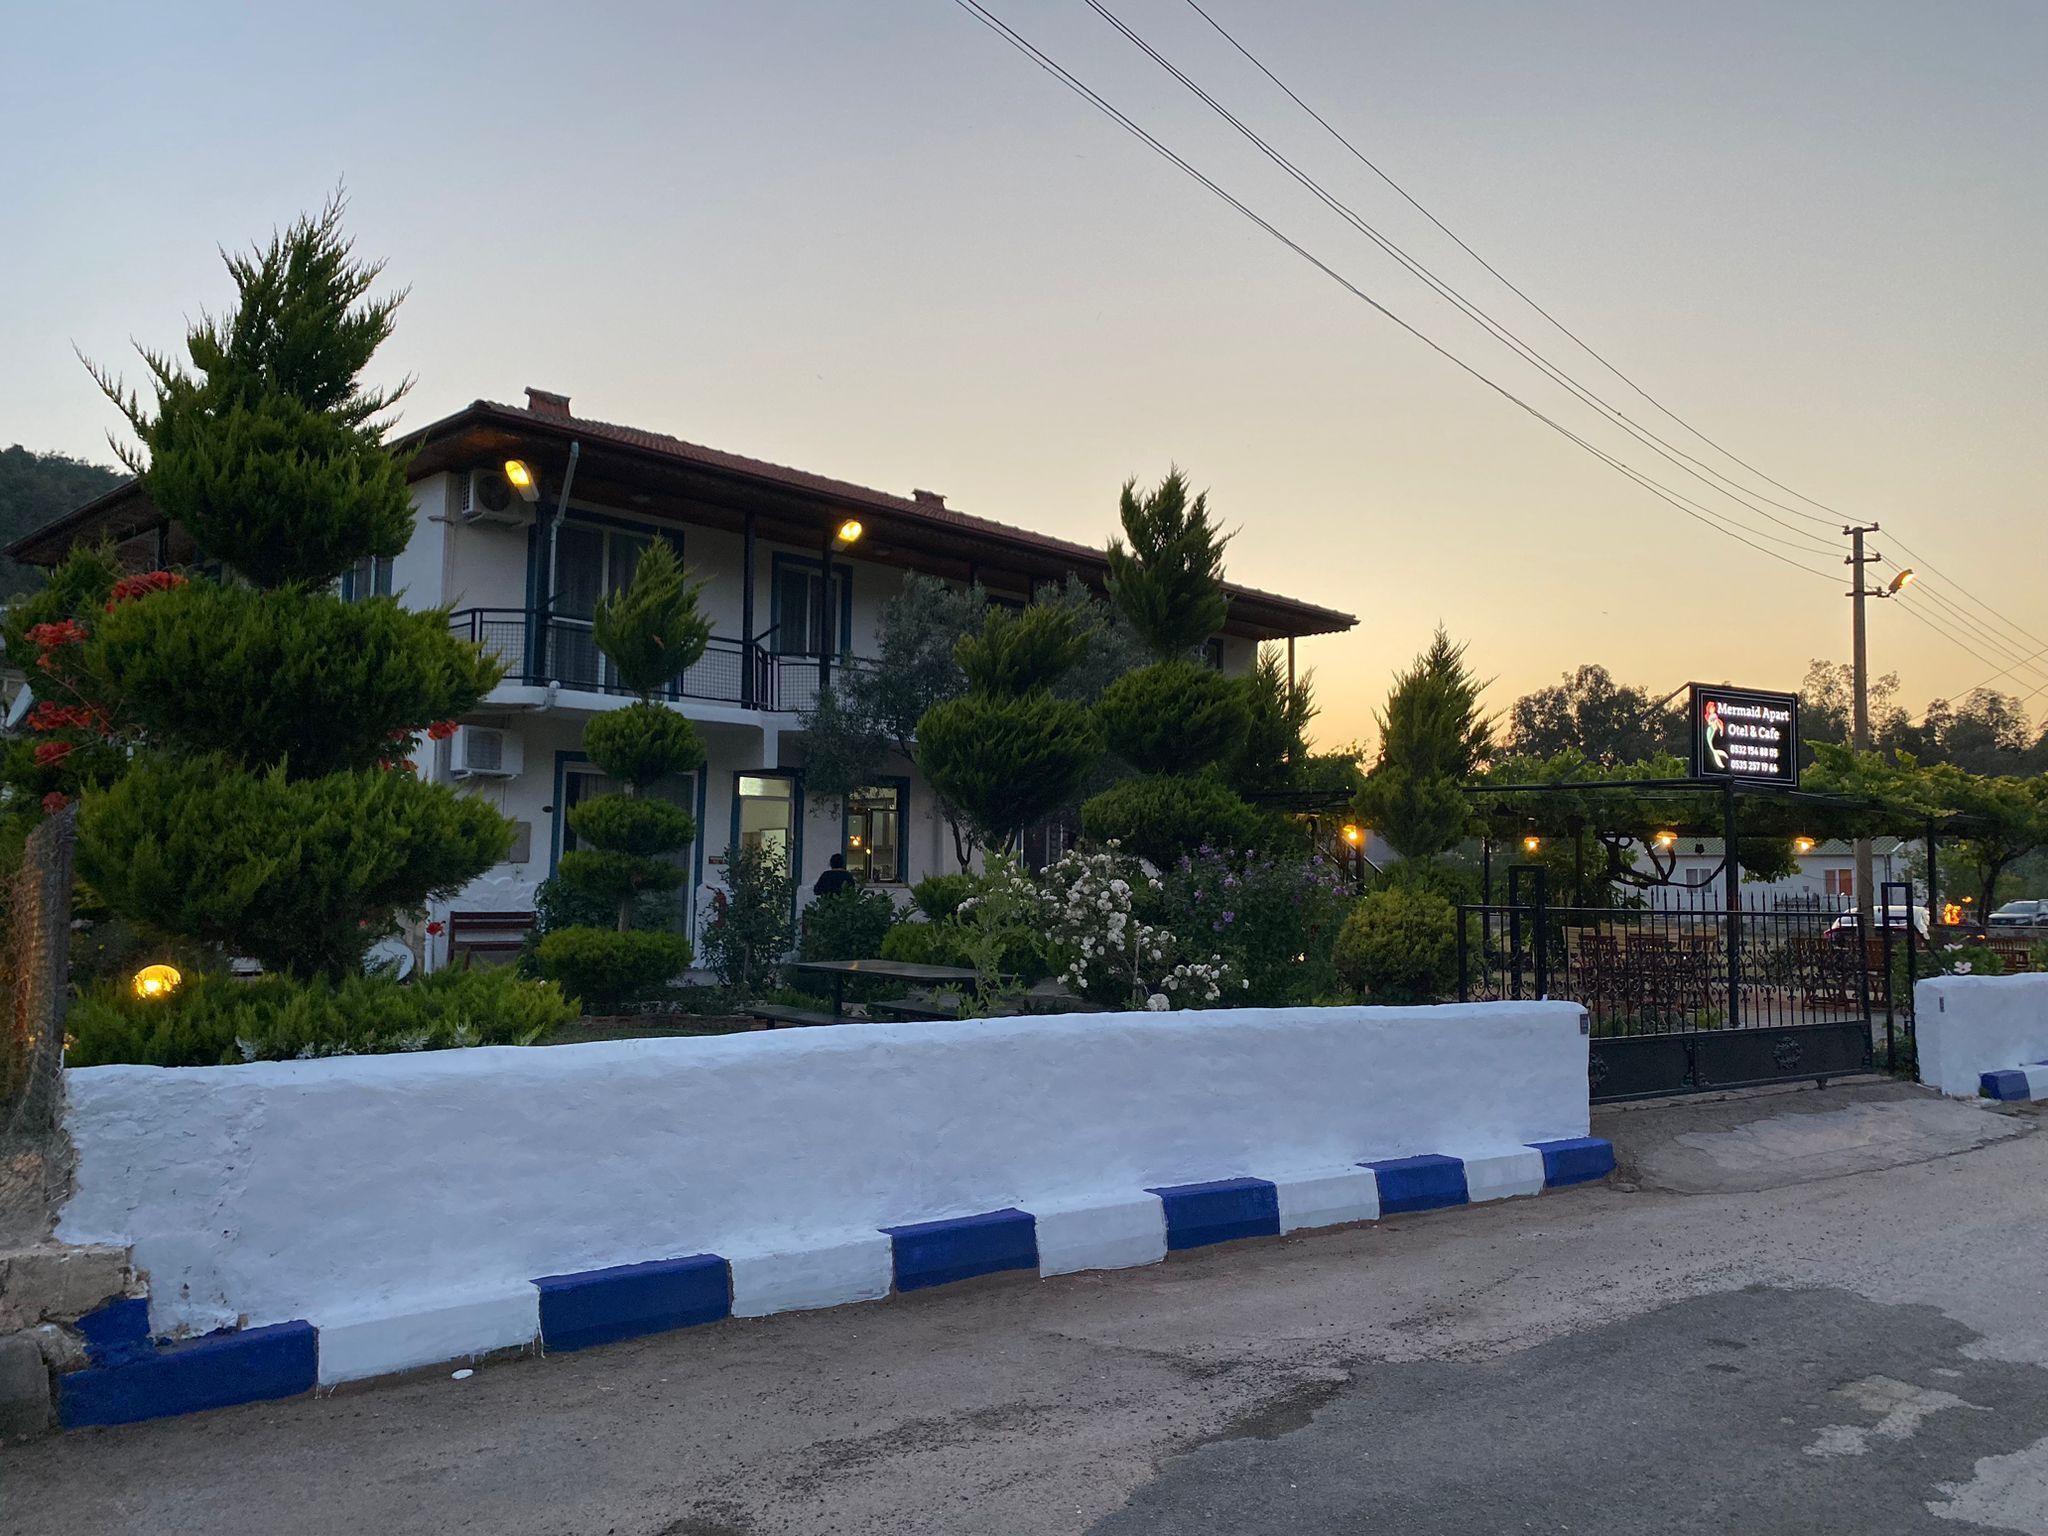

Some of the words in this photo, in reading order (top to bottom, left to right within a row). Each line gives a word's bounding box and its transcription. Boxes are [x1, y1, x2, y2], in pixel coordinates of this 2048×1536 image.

[1717, 702, 1761, 718] Mermaid
[1763, 707, 1790, 722] Apart
[1728, 724, 1748, 737] Otel
[1750, 726, 1757, 738] &
[1758, 726, 1780, 740] Cafe
